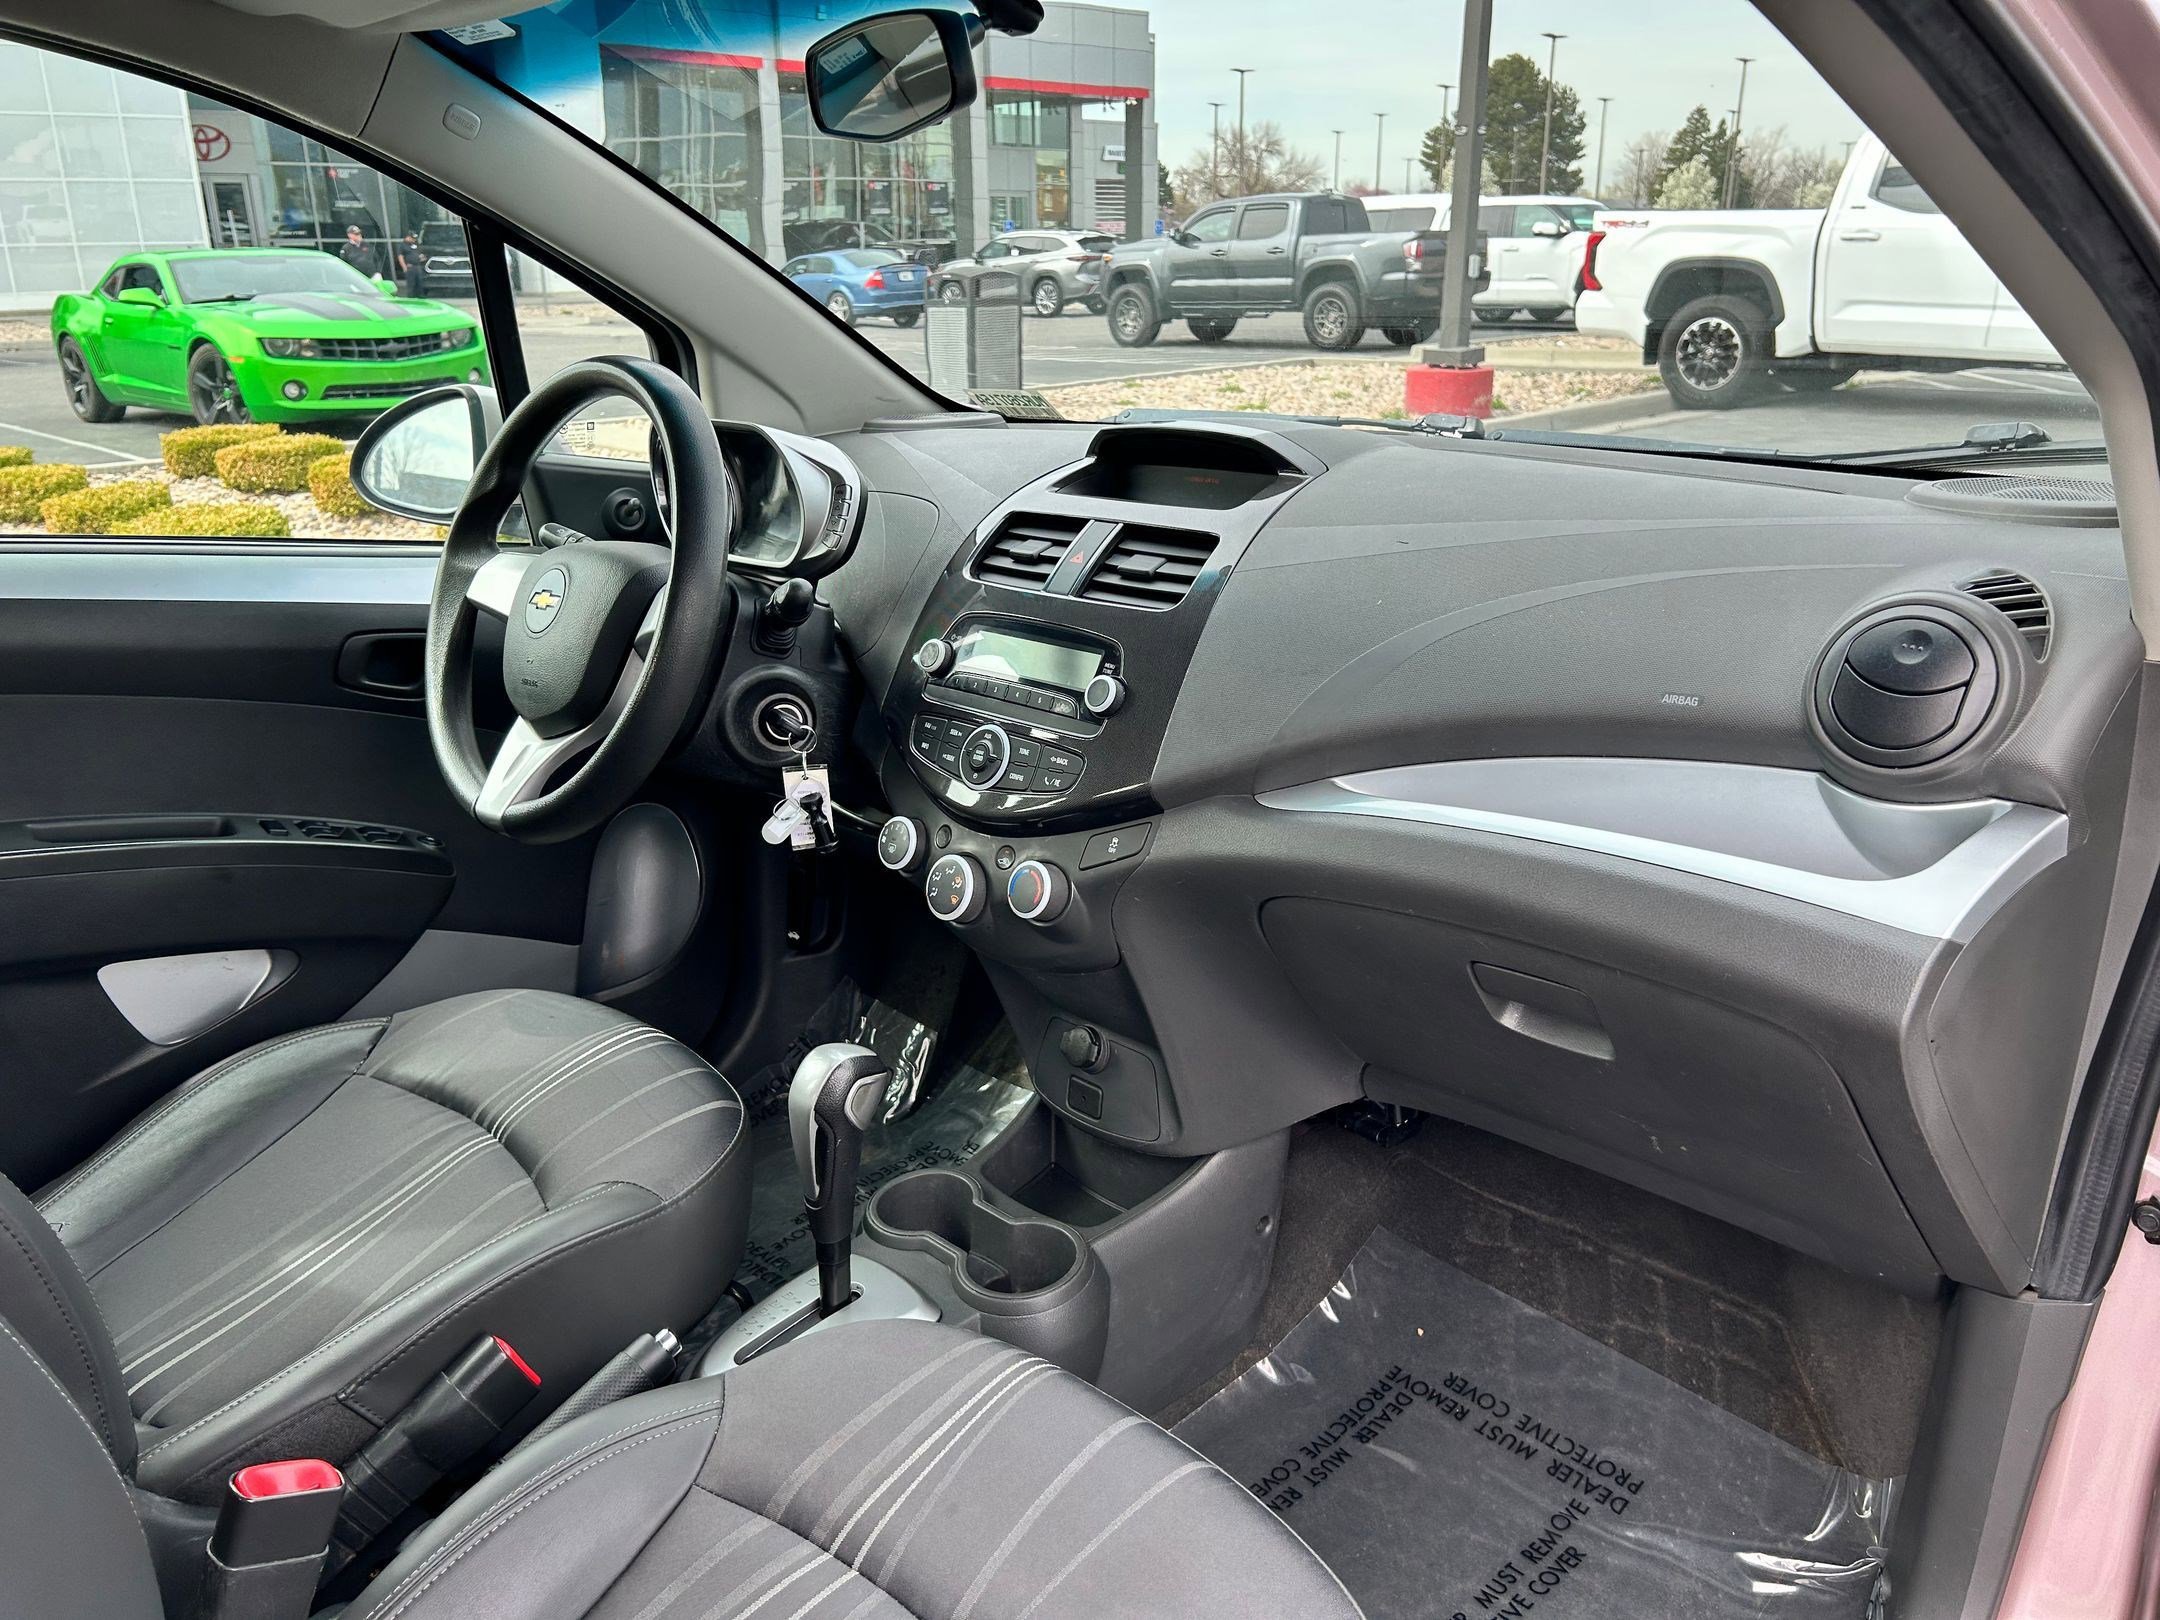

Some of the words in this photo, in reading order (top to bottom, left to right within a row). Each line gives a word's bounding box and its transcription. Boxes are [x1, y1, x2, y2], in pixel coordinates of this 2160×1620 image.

[1661, 693, 1699, 707] AIRBAG
[1299, 1379, 1393, 1460] PROTECTIVE
[1352, 1391, 1413, 1445] DEALER
[1385, 1365, 1471, 1422] REMOVE
[1443, 1371, 1510, 1419] COVER
[1474, 1420, 1539, 1461] MUST
[1515, 1413, 1645, 1495] PROTECTIVE
[1250, 1458, 1301, 1499] COVE
[1303, 1447, 1353, 1488] MUST
[1546, 1458, 1630, 1515] DEALER
[1473, 1561, 1525, 1609] MUST
[1520, 1498, 1590, 1564] REMOVE
[1528, 1545, 1588, 1595] COVER
